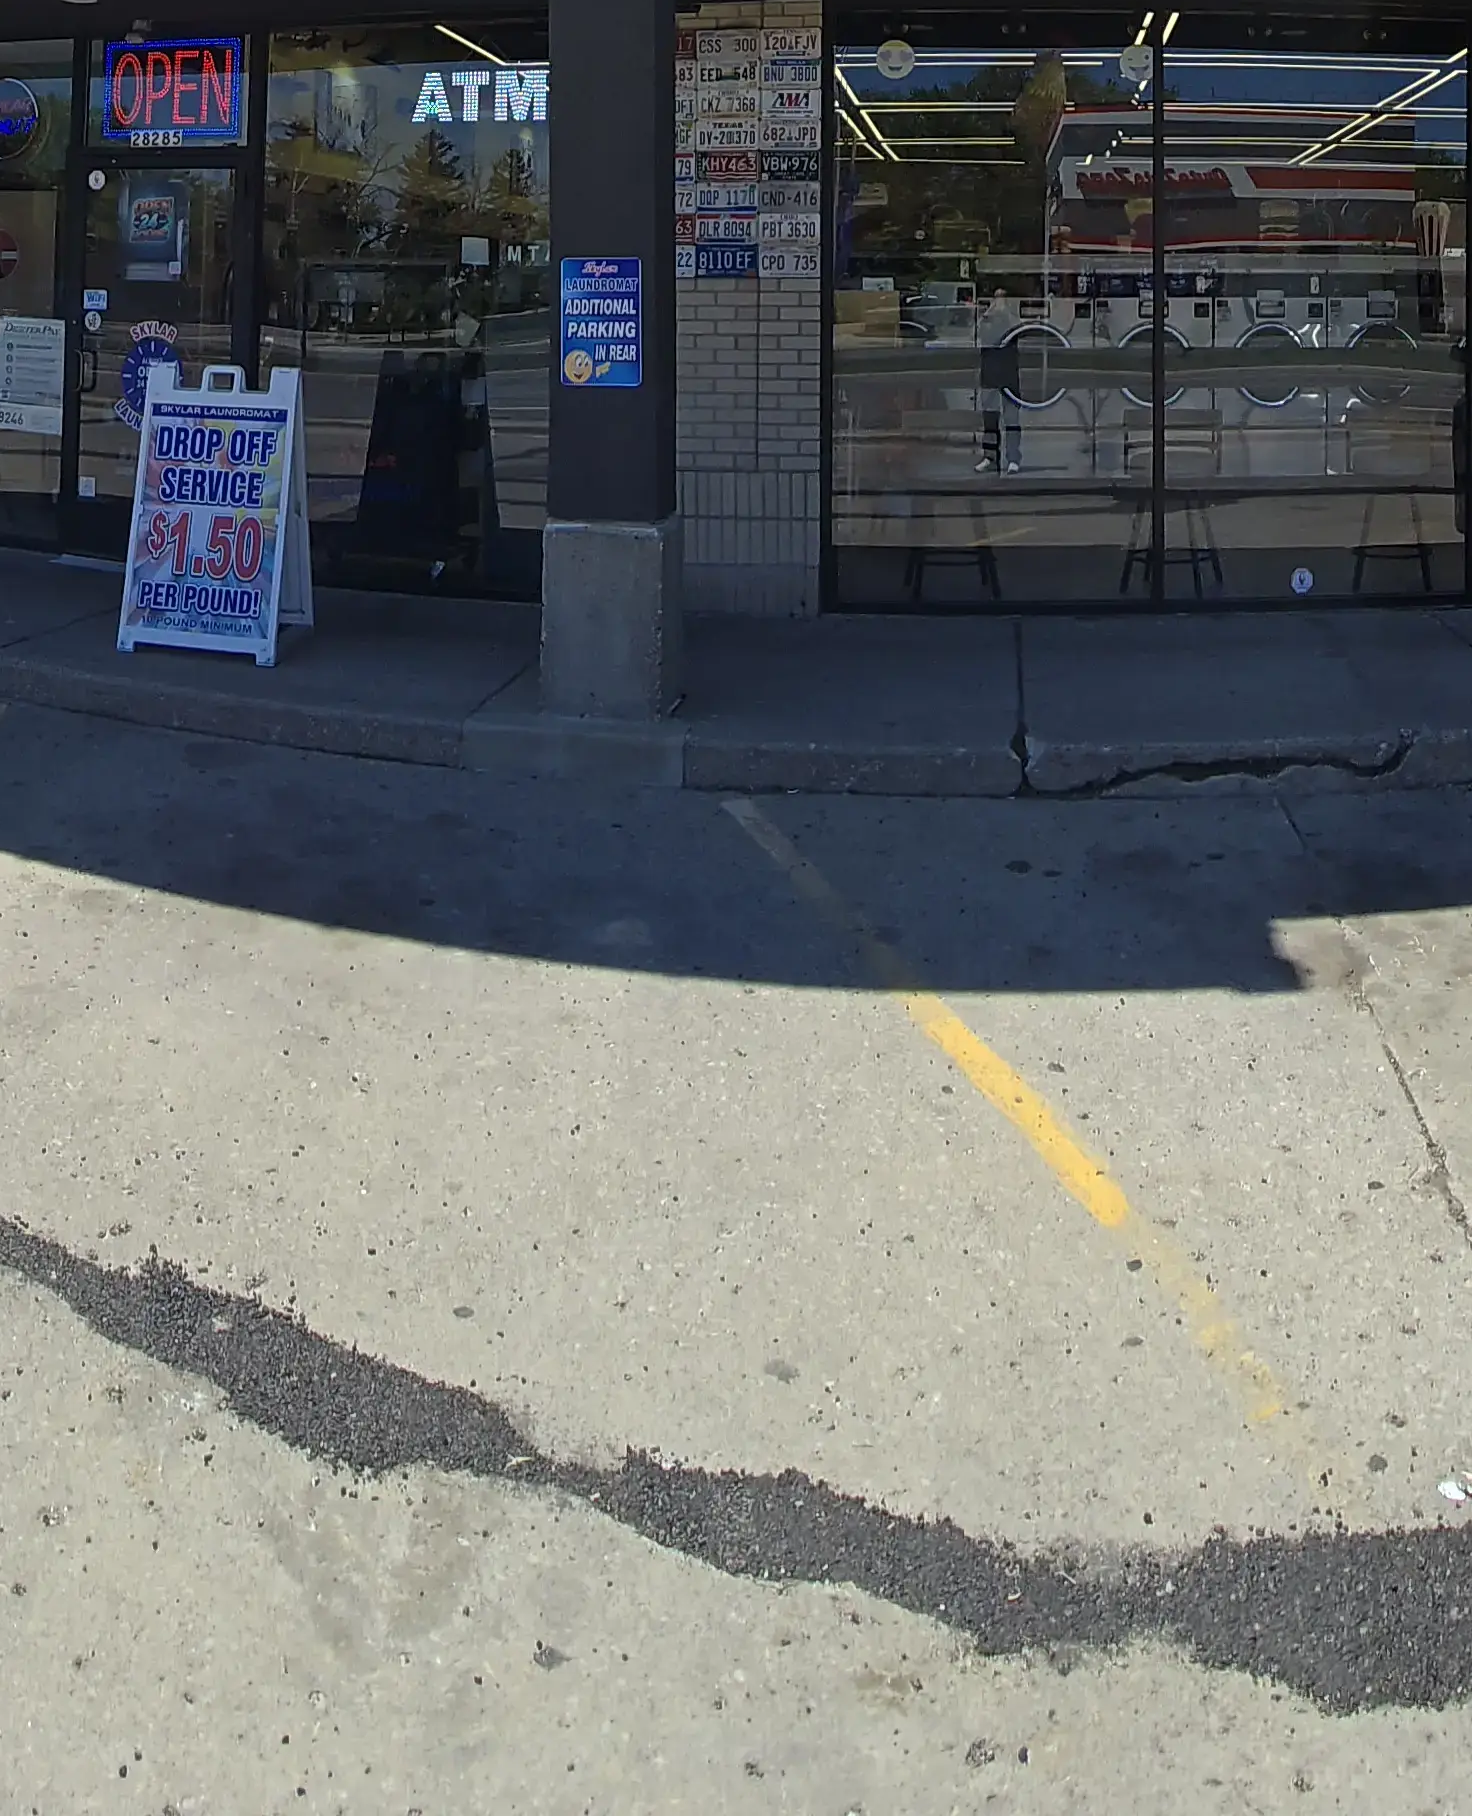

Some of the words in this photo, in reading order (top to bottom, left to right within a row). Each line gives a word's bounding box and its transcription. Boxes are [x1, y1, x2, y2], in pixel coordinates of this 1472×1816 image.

[699, 39, 722, 53] CSS
[735, 38, 757, 52] 300
[700, 68, 722, 82] EED
[113, 50, 232, 127] OPEN
[412, 70, 550, 122] ATM
[132, 132, 181, 147] 28285
[763, 127, 784, 141] 682
[699, 252, 732, 269] 8110
[736, 252, 755, 267] EF
[793, 255, 817, 270] 735
[565, 278, 638, 292] LAUNDROMAT
[565, 298, 636, 315] ADDITIONAL
[130, 320, 178, 344] SKYLAR
[567, 322, 636, 337] PARKING
[595, 345, 606, 360] IN
[609, 345, 636, 361] REAR
[160, 404, 201, 415] SKYLAR
[204, 406, 279, 418] LAUNDROMAT
[156, 425, 224, 460] DROP
[229, 429, 277, 465] OFF
[160, 467, 265, 507] SERVICE
[148, 510, 265, 582] $1.50
[138, 581, 178, 609] PER
[183, 584, 261, 618] POUND!
[157, 616, 197, 628] POUND
[200, 621, 252, 634] MINIMUM
